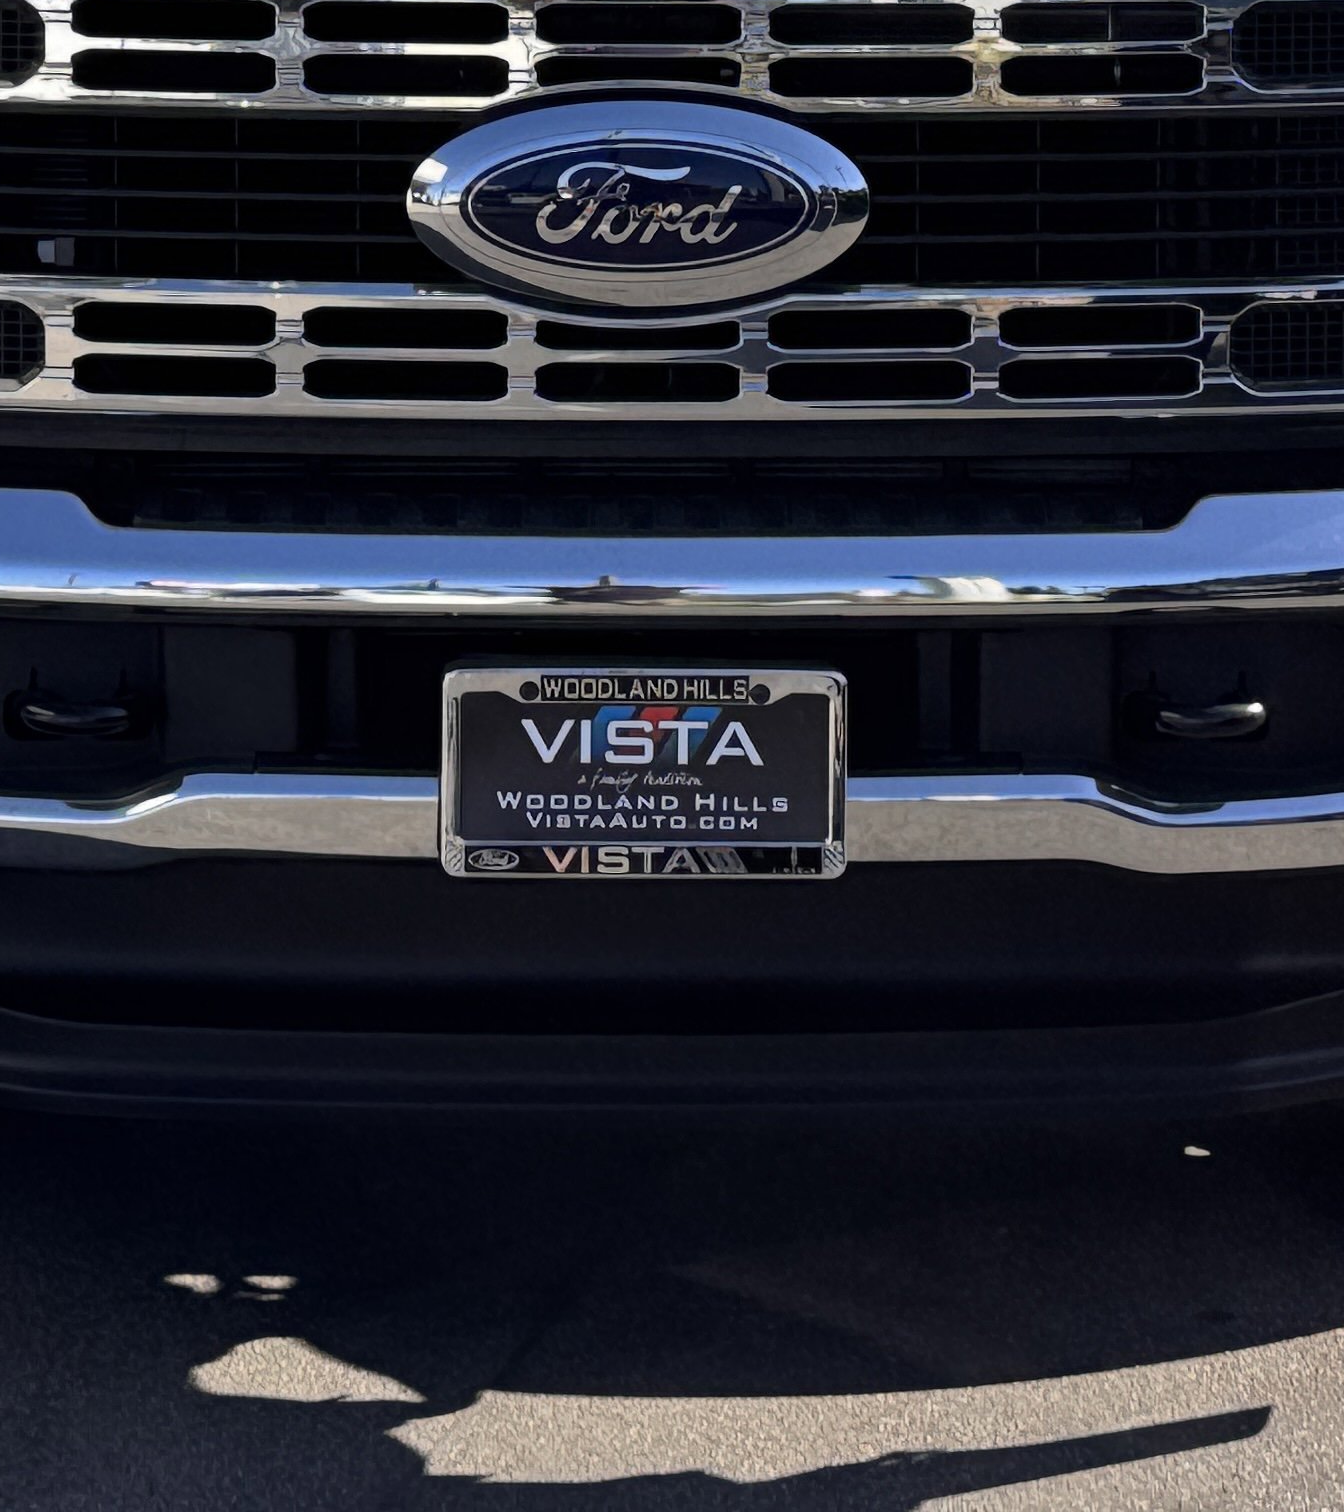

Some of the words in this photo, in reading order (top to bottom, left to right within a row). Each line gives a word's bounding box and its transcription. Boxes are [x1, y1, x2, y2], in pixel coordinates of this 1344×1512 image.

[536, 161, 743, 245] Ford
[543, 677, 680, 701] WOODLAND
[683, 678, 749, 700] HILLS
[520, 718, 765, 767] VISTA
[542, 846, 702, 875] VISTA
